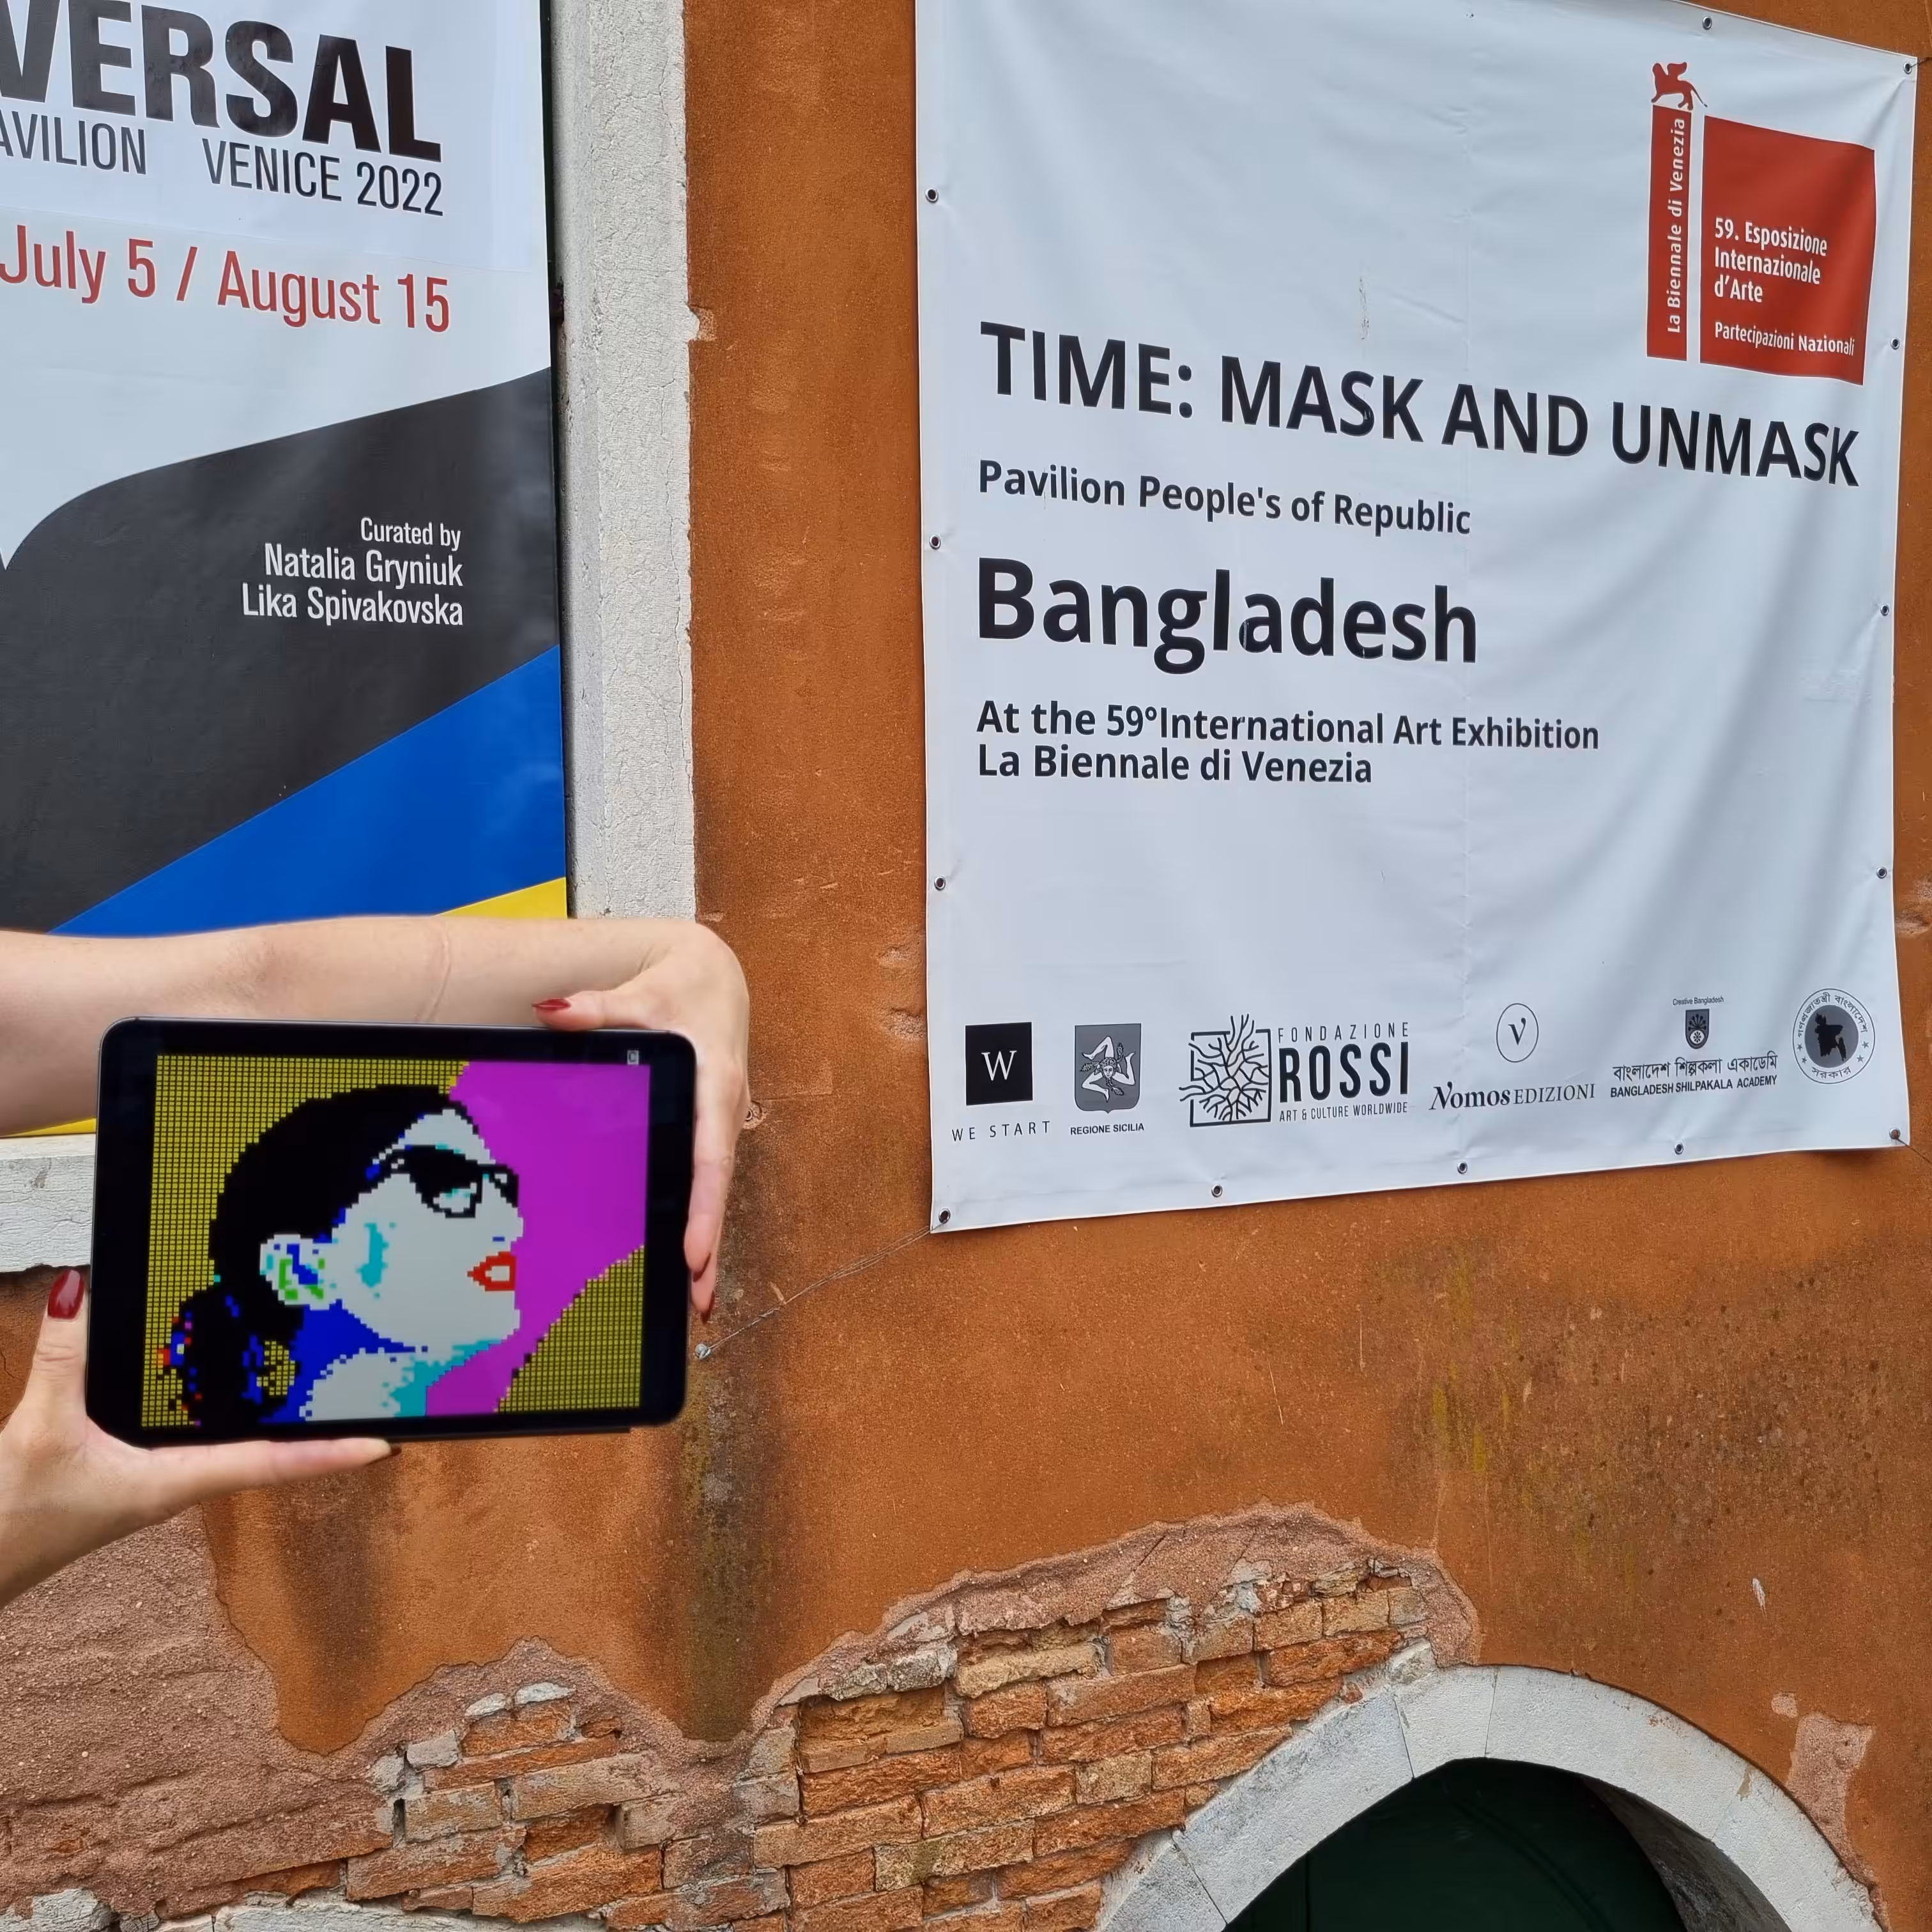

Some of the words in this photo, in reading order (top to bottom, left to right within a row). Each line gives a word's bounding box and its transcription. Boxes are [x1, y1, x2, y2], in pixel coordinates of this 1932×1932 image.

[0, 0, 441, 162] VERSAL
[1669, 118, 1685, 192] Venezia
[203, 138, 342, 201] VENICE
[356, 160, 444, 217] 2022
[1667, 199, 1683, 217] di
[1715, 217, 1739, 241] 59.
[1745, 222, 1827, 257] Esposizione
[0, 224, 106, 304] July
[128, 238, 156, 298] 5
[218, 250, 381, 327] August
[397, 273, 449, 333] 15
[1667, 224, 1682, 308] Biennale
[1715, 247, 1821, 285] Internazionale
[1715, 275, 1763, 302] d'Arte
[1667, 316, 1681, 332] La
[1715, 321, 1794, 350] Partecipazioni
[1798, 335, 1855, 356] Nazionali
[980, 321, 1193, 418] TIME:
[1222, 355, 1424, 443] MASK
[1441, 383, 1588, 457] AND
[1612, 401, 1860, 487] UNMASK
[979, 459, 1124, 506] Pavilion
[1140, 475, 1280, 523] People's
[1291, 491, 1325, 522] of
[1335, 494, 1471, 537] Republic
[361, 518, 433, 545] Curated
[441, 523, 461, 551] by
[264, 542, 355, 580] Natalia
[365, 549, 463, 589] Gryniuk
[242, 582, 296, 617] Lika
[308, 586, 463, 625] Spivakovska
[978, 556, 1476, 675] Bangladesh
[977, 700, 1020, 734] At
[1031, 701, 1096, 736] the
[1393, 714, 1441, 746] Art
[1452, 716, 1599, 749] Exhibition
[978, 744, 1020, 777] La
[1034, 744, 1189, 780] Biennale
[1200, 748, 1230, 780] di
[1241, 751, 1372, 783] Venezia
[1673, 997, 1692, 1006] Creative
[1694, 995, 1724, 1006] Bangladesh
[1278, 1022, 1408, 1043] FONDAZIONE
[981, 1050, 1016, 1082] W
[1279, 1041, 1408, 1103] ROSSI
[1613, 1061, 1671, 1082] বাংলাদেশ
[1611, 1083, 1673, 1098] BANGLADESH
[1676, 1079, 1733, 1093] SHILPAKALA
[1736, 1075, 1777, 1089] ACADEMY
[1070, 1124, 1110, 1135] REGIONE
[1113, 1123, 1144, 1133] SICILIA
[1280, 1110, 1298, 1122] ART
[1302, 1109, 1307, 1120] &
[1311, 1106, 1348, 1119] CULTURE
[1353, 1102, 1407, 1116] WORLDWIDE
[952, 1127, 976, 1142] WE
[990, 1121, 1050, 1138] START
